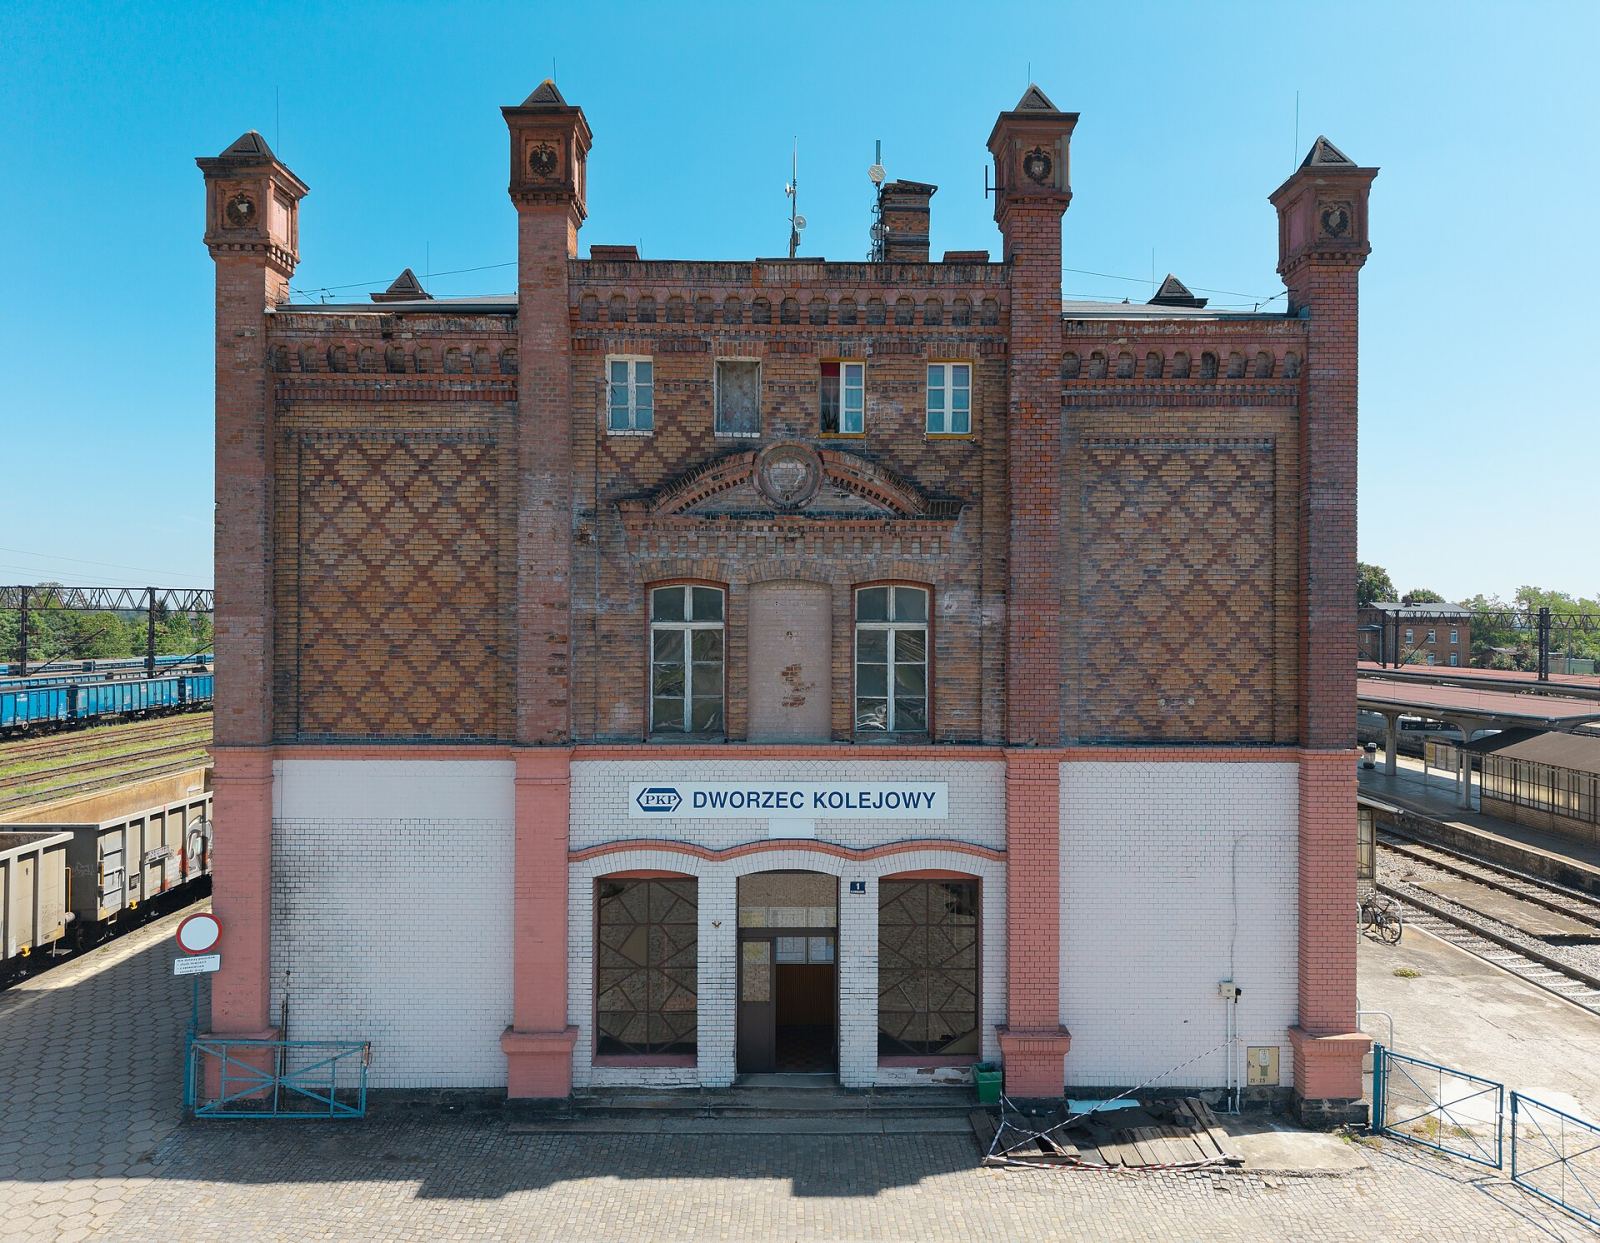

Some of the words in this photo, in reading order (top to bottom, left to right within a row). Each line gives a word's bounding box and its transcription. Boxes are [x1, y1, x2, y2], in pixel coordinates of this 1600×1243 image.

[644, 794, 677, 805] PKP
[693, 791, 805, 809] DWORZEC
[813, 791, 936, 809] KOLEJOWY
